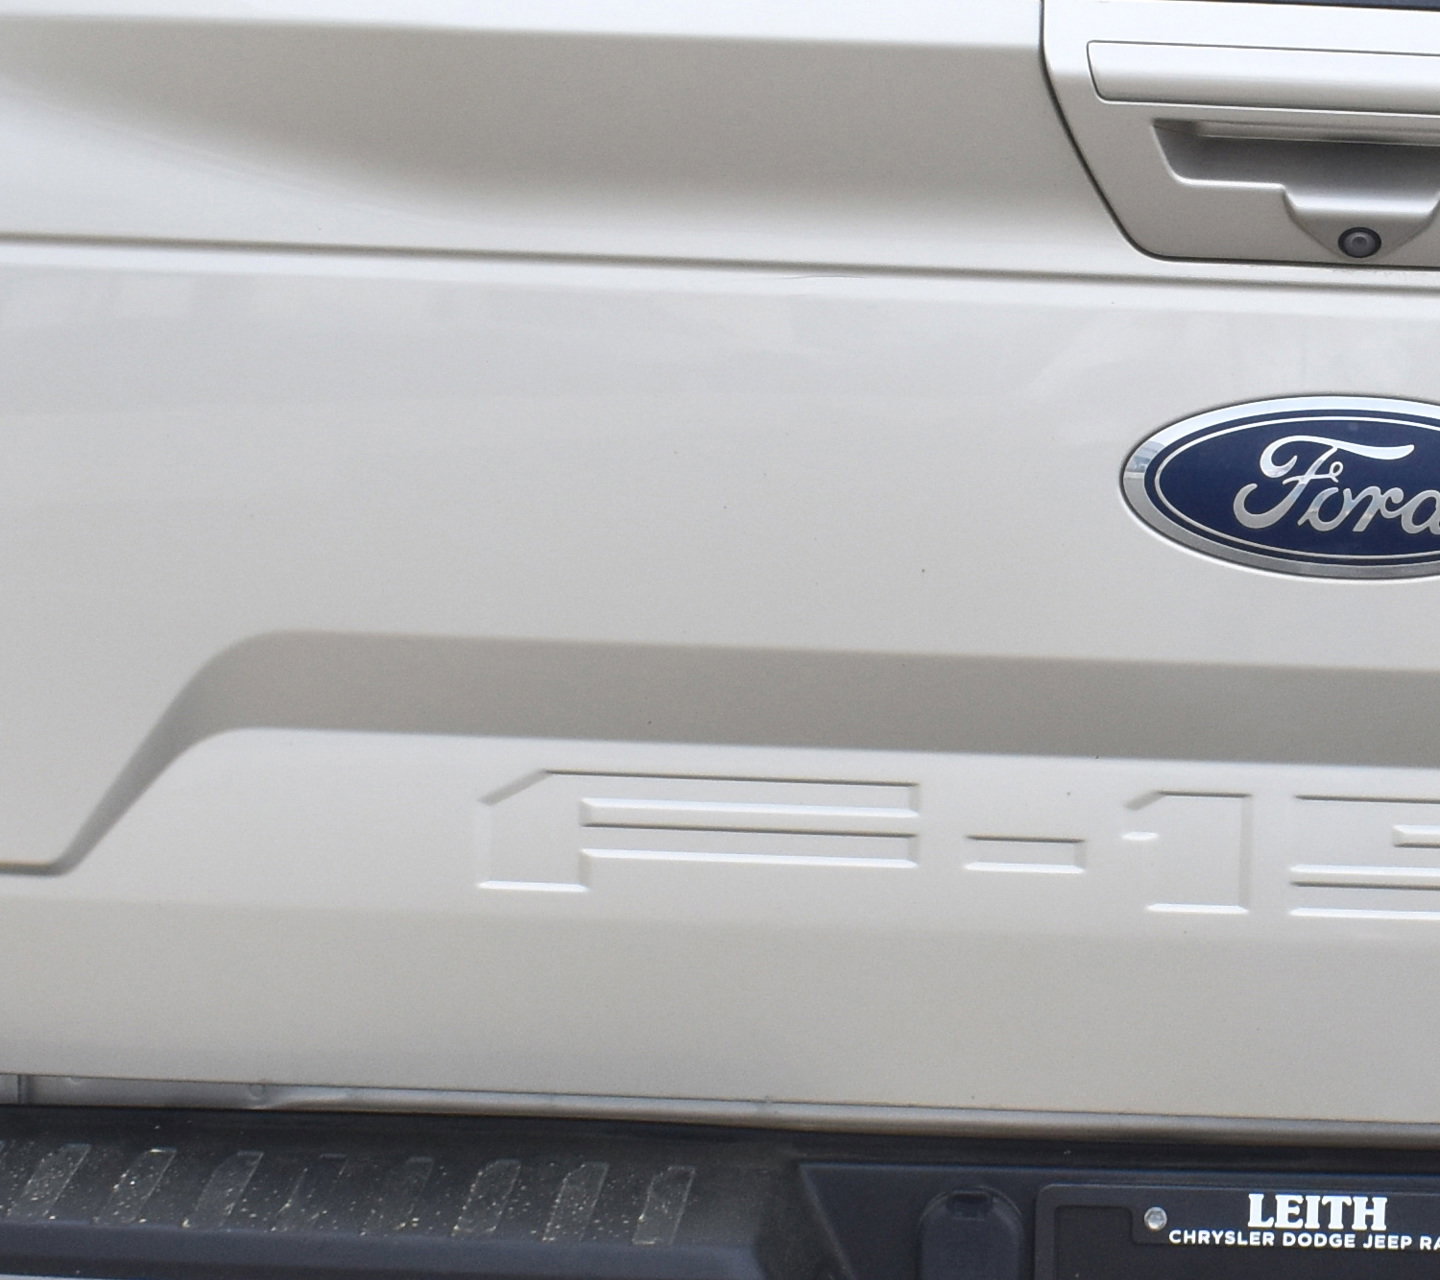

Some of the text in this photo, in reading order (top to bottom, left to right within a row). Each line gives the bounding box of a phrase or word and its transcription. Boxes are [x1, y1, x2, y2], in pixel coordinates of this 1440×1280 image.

[1247, 1193, 1388, 1231] LEITH
[1168, 1229, 1275, 1247] CHRYSLER
[1282, 1232, 1356, 1249] DODGE
[1363, 1234, 1413, 1251] JEEP
